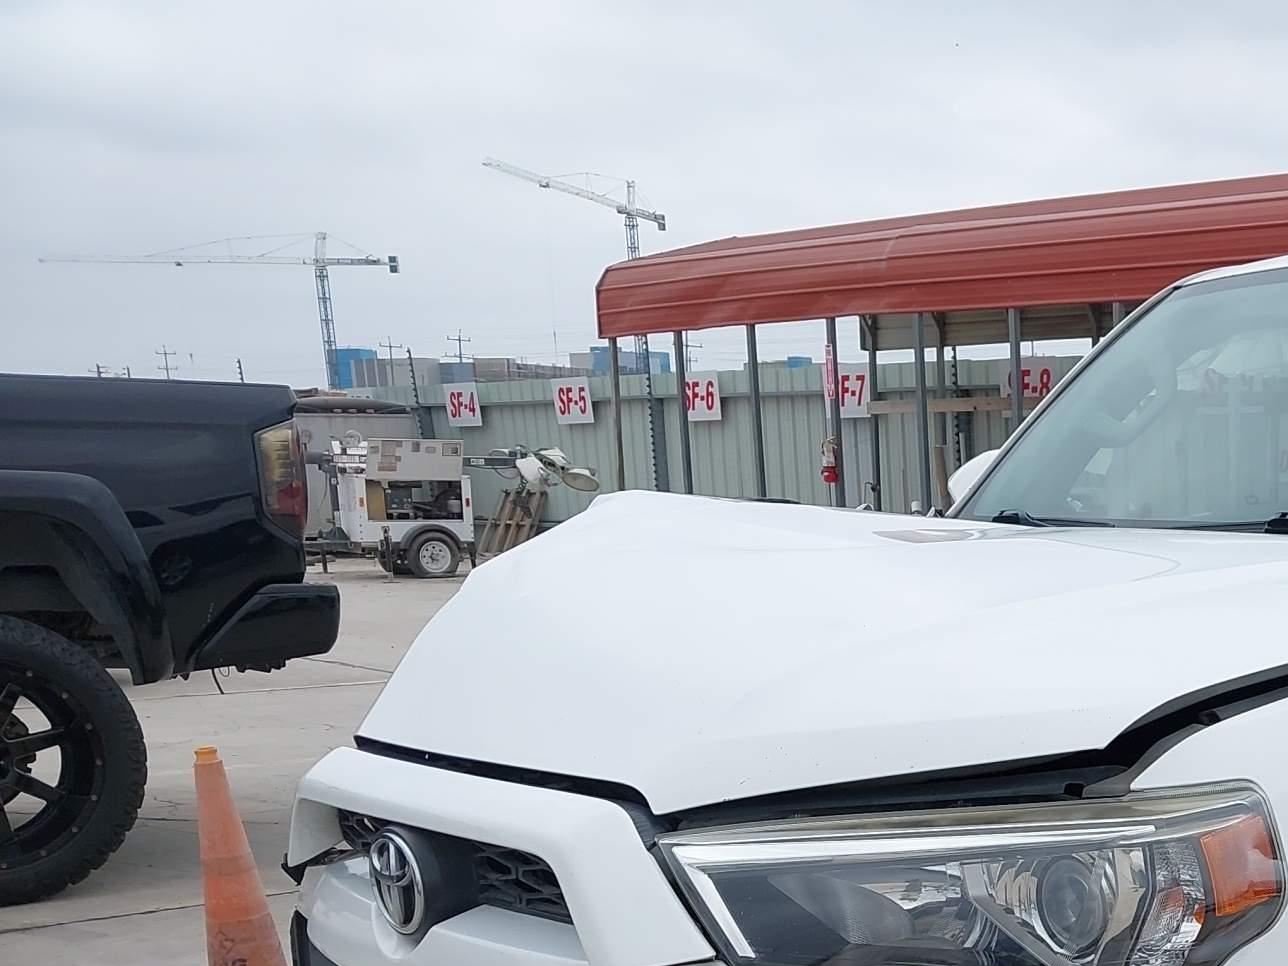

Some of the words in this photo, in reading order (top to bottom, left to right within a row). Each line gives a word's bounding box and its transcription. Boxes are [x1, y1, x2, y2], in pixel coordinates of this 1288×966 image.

[839, 374, 865, 407] F-7
[1008, 368, 1051, 398] F-8
[449, 391, 476, 418] SF-4
[557, 386, 587, 416] SF-5
